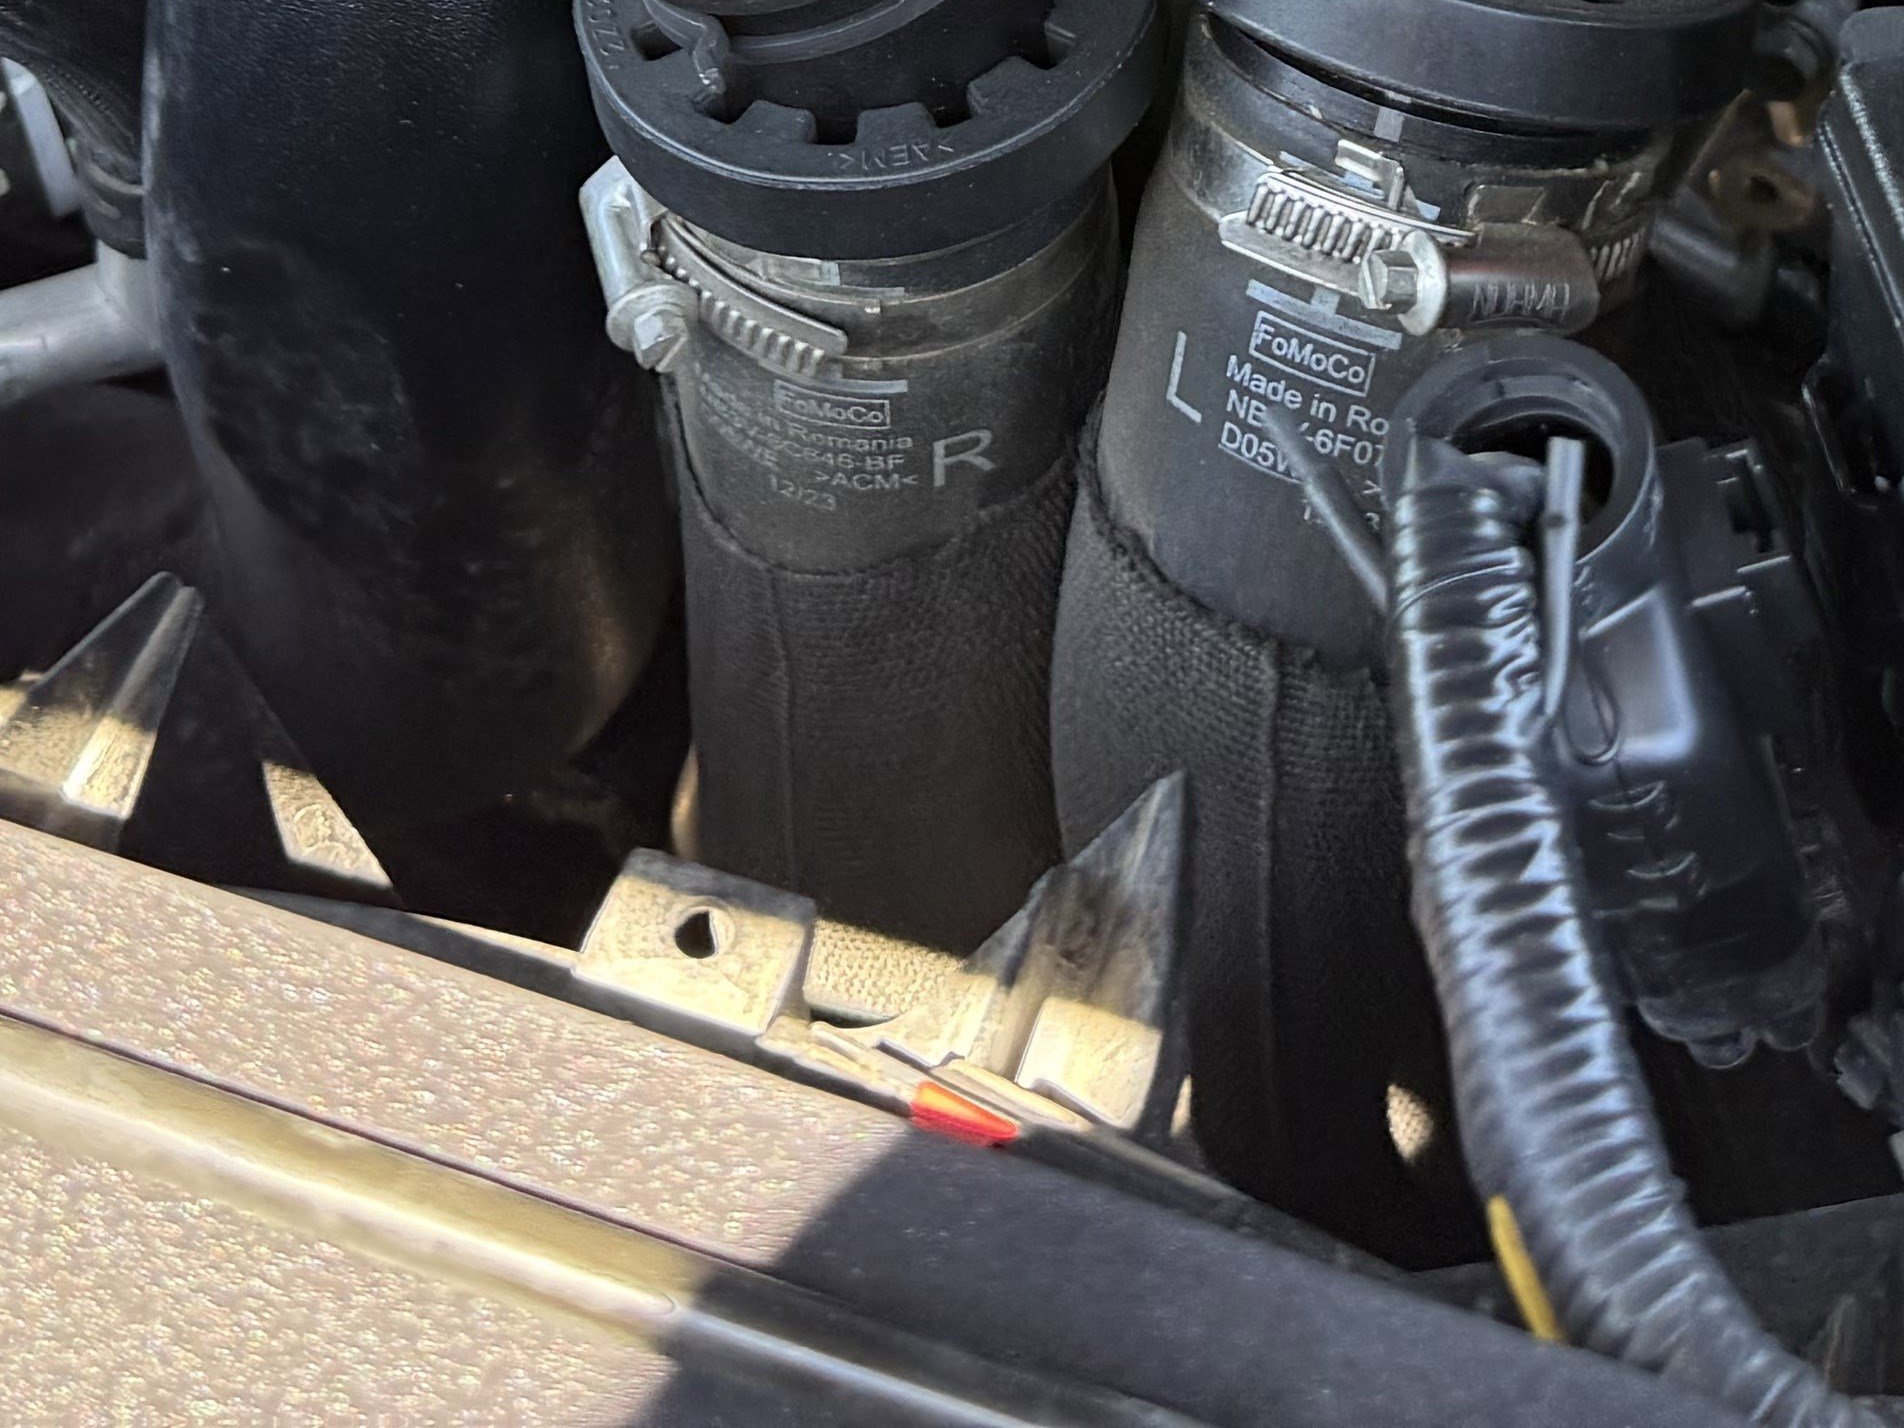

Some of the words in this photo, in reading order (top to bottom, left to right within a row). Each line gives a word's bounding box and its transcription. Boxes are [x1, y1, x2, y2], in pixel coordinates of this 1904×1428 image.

[1166, 331, 1203, 423] L
[1256, 326, 1366, 386] FoMoCo
[1227, 355, 1303, 410] Made
[1311, 393, 1338, 423] in
[1347, 407, 1390, 436] Ro
[788, 422, 913, 450] Romania
[933, 429, 995, 487] R
